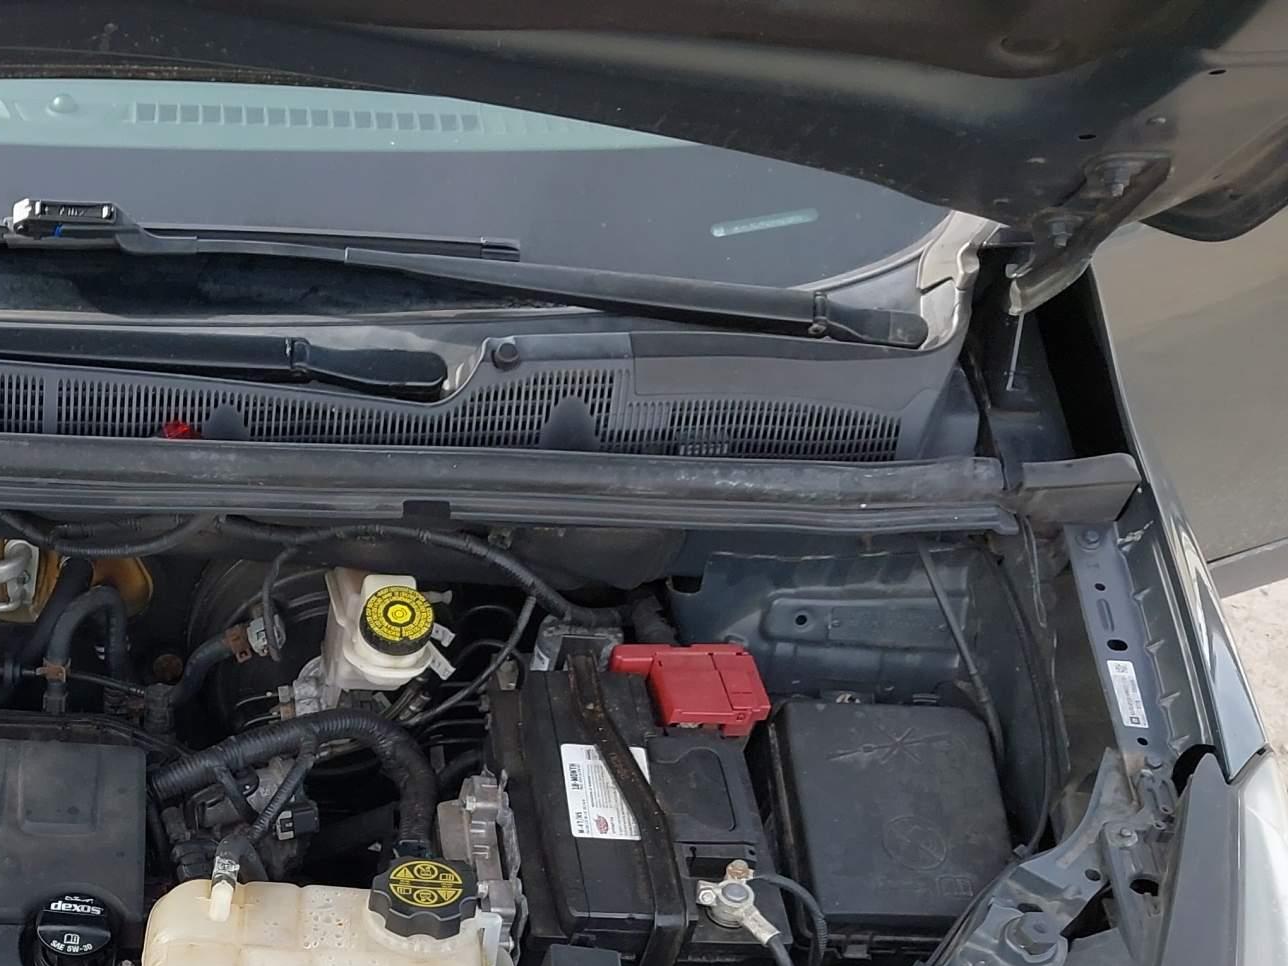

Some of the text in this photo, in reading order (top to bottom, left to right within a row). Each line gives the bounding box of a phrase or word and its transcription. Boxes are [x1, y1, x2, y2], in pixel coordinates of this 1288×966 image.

[50, 900, 102, 915] dexos
[50, 940, 93, 953] SAE 5W-30
